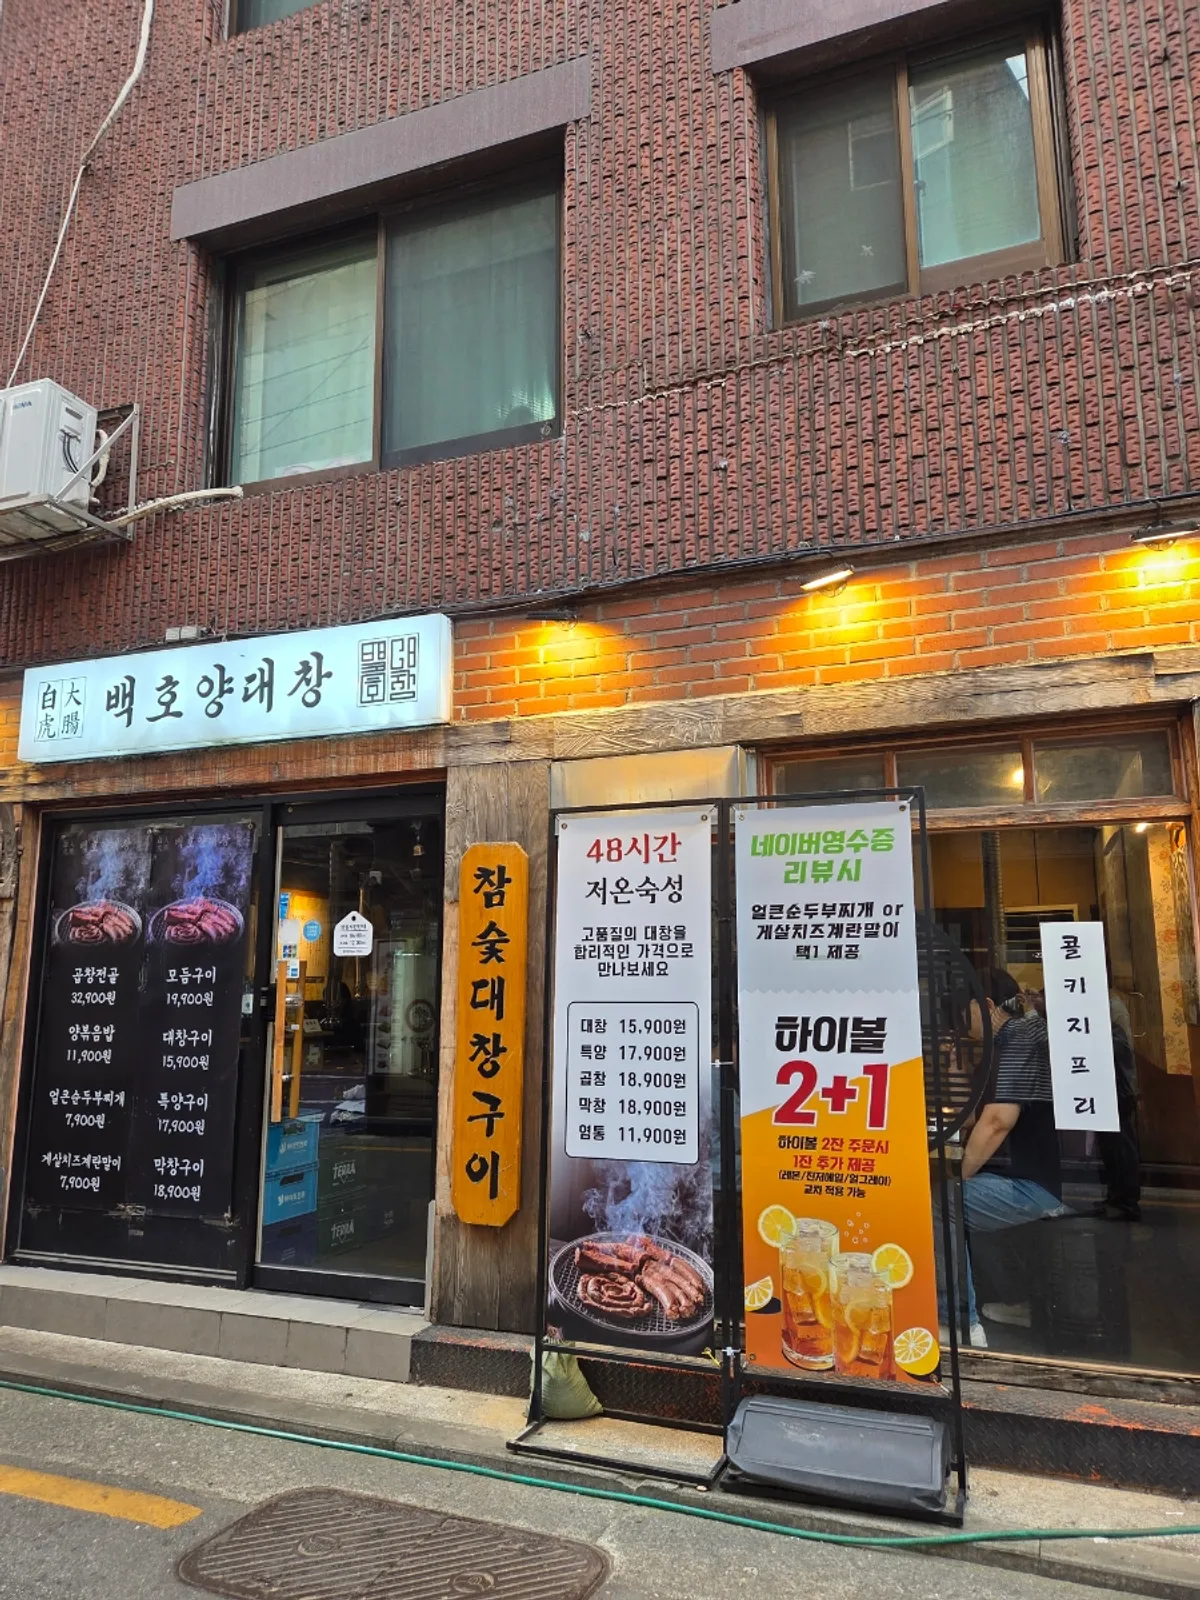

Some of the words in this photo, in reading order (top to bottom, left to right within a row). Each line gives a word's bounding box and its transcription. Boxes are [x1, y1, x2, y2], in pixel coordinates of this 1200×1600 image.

[105, 651, 334, 728] 백호양대창
[586, 832, 682, 864] 48시간
[751, 828, 895, 857] 네이버영수증
[783, 859, 862, 884] 리뷰시
[585, 874, 683, 905] 저온숙성
[752, 902, 875, 920] 얼큰순두부찌개
[883, 904, 904, 916] or
[581, 926, 637, 942] 고품질의
[644, 925, 687, 941] 대창을
[756, 921, 900, 940] 게살치즈계란말이
[573, 944, 630, 960] 합리적인
[638, 943, 694, 959] 가격으로
[796, 944, 819, 960] 택1
[827, 944, 860, 960] 제공
[72, 967, 119, 984] 곱창전골
[166, 965, 216, 985] 모듬구이
[597, 961, 669, 977] 만나보세요
[70, 991, 116, 1006] 32,900원
[166, 991, 214, 1007] 19,900원
[68, 1024, 115, 1042] 양볶음밥
[465, 864, 512, 1200] 참숯대창구이
[580, 1018, 608, 1034] 대창
[619, 1018, 687, 1035] 15,900원
[1060, 935, 1096, 1115] 콜키지프리
[162, 1028, 212, 1047] 대창구이
[775, 1016, 888, 1054] 하이볼
[66, 1049, 112, 1064] 11,900원
[580, 1044, 607, 1060] 특양
[618, 1045, 687, 1062] 17,900원
[162, 1055, 210, 1070] 15,900원
[580, 1071, 607, 1087] 곱창
[618, 1072, 687, 1089] 18,900원
[49, 1088, 125, 1108] 얼큰순두부찌개
[157, 1092, 208, 1112] 특양구이
[772, 1060, 890, 1129] 2+1
[578, 1097, 607, 1114] 막창
[618, 1099, 687, 1117] 18,900원
[65, 1113, 105, 1129] 7,900원
[158, 1118, 205, 1135] 17,900원
[578, 1124, 605, 1141] 염통
[618, 1127, 687, 1145] 11,900원
[778, 1135, 818, 1150] 하이볼
[821, 1138, 844, 1152] 2잔
[848, 1138, 889, 1154] 주문시
[153, 1156, 204, 1178] 막창구이
[793, 1155, 812, 1169] 1잔
[817, 1156, 843, 1171] 추가
[847, 1158, 875, 1173] 제공
[59, 1175, 100, 1192] 7,900원
[847, 1187, 866, 1198] 가능
[154, 1184, 201, 1202] 18,900원
